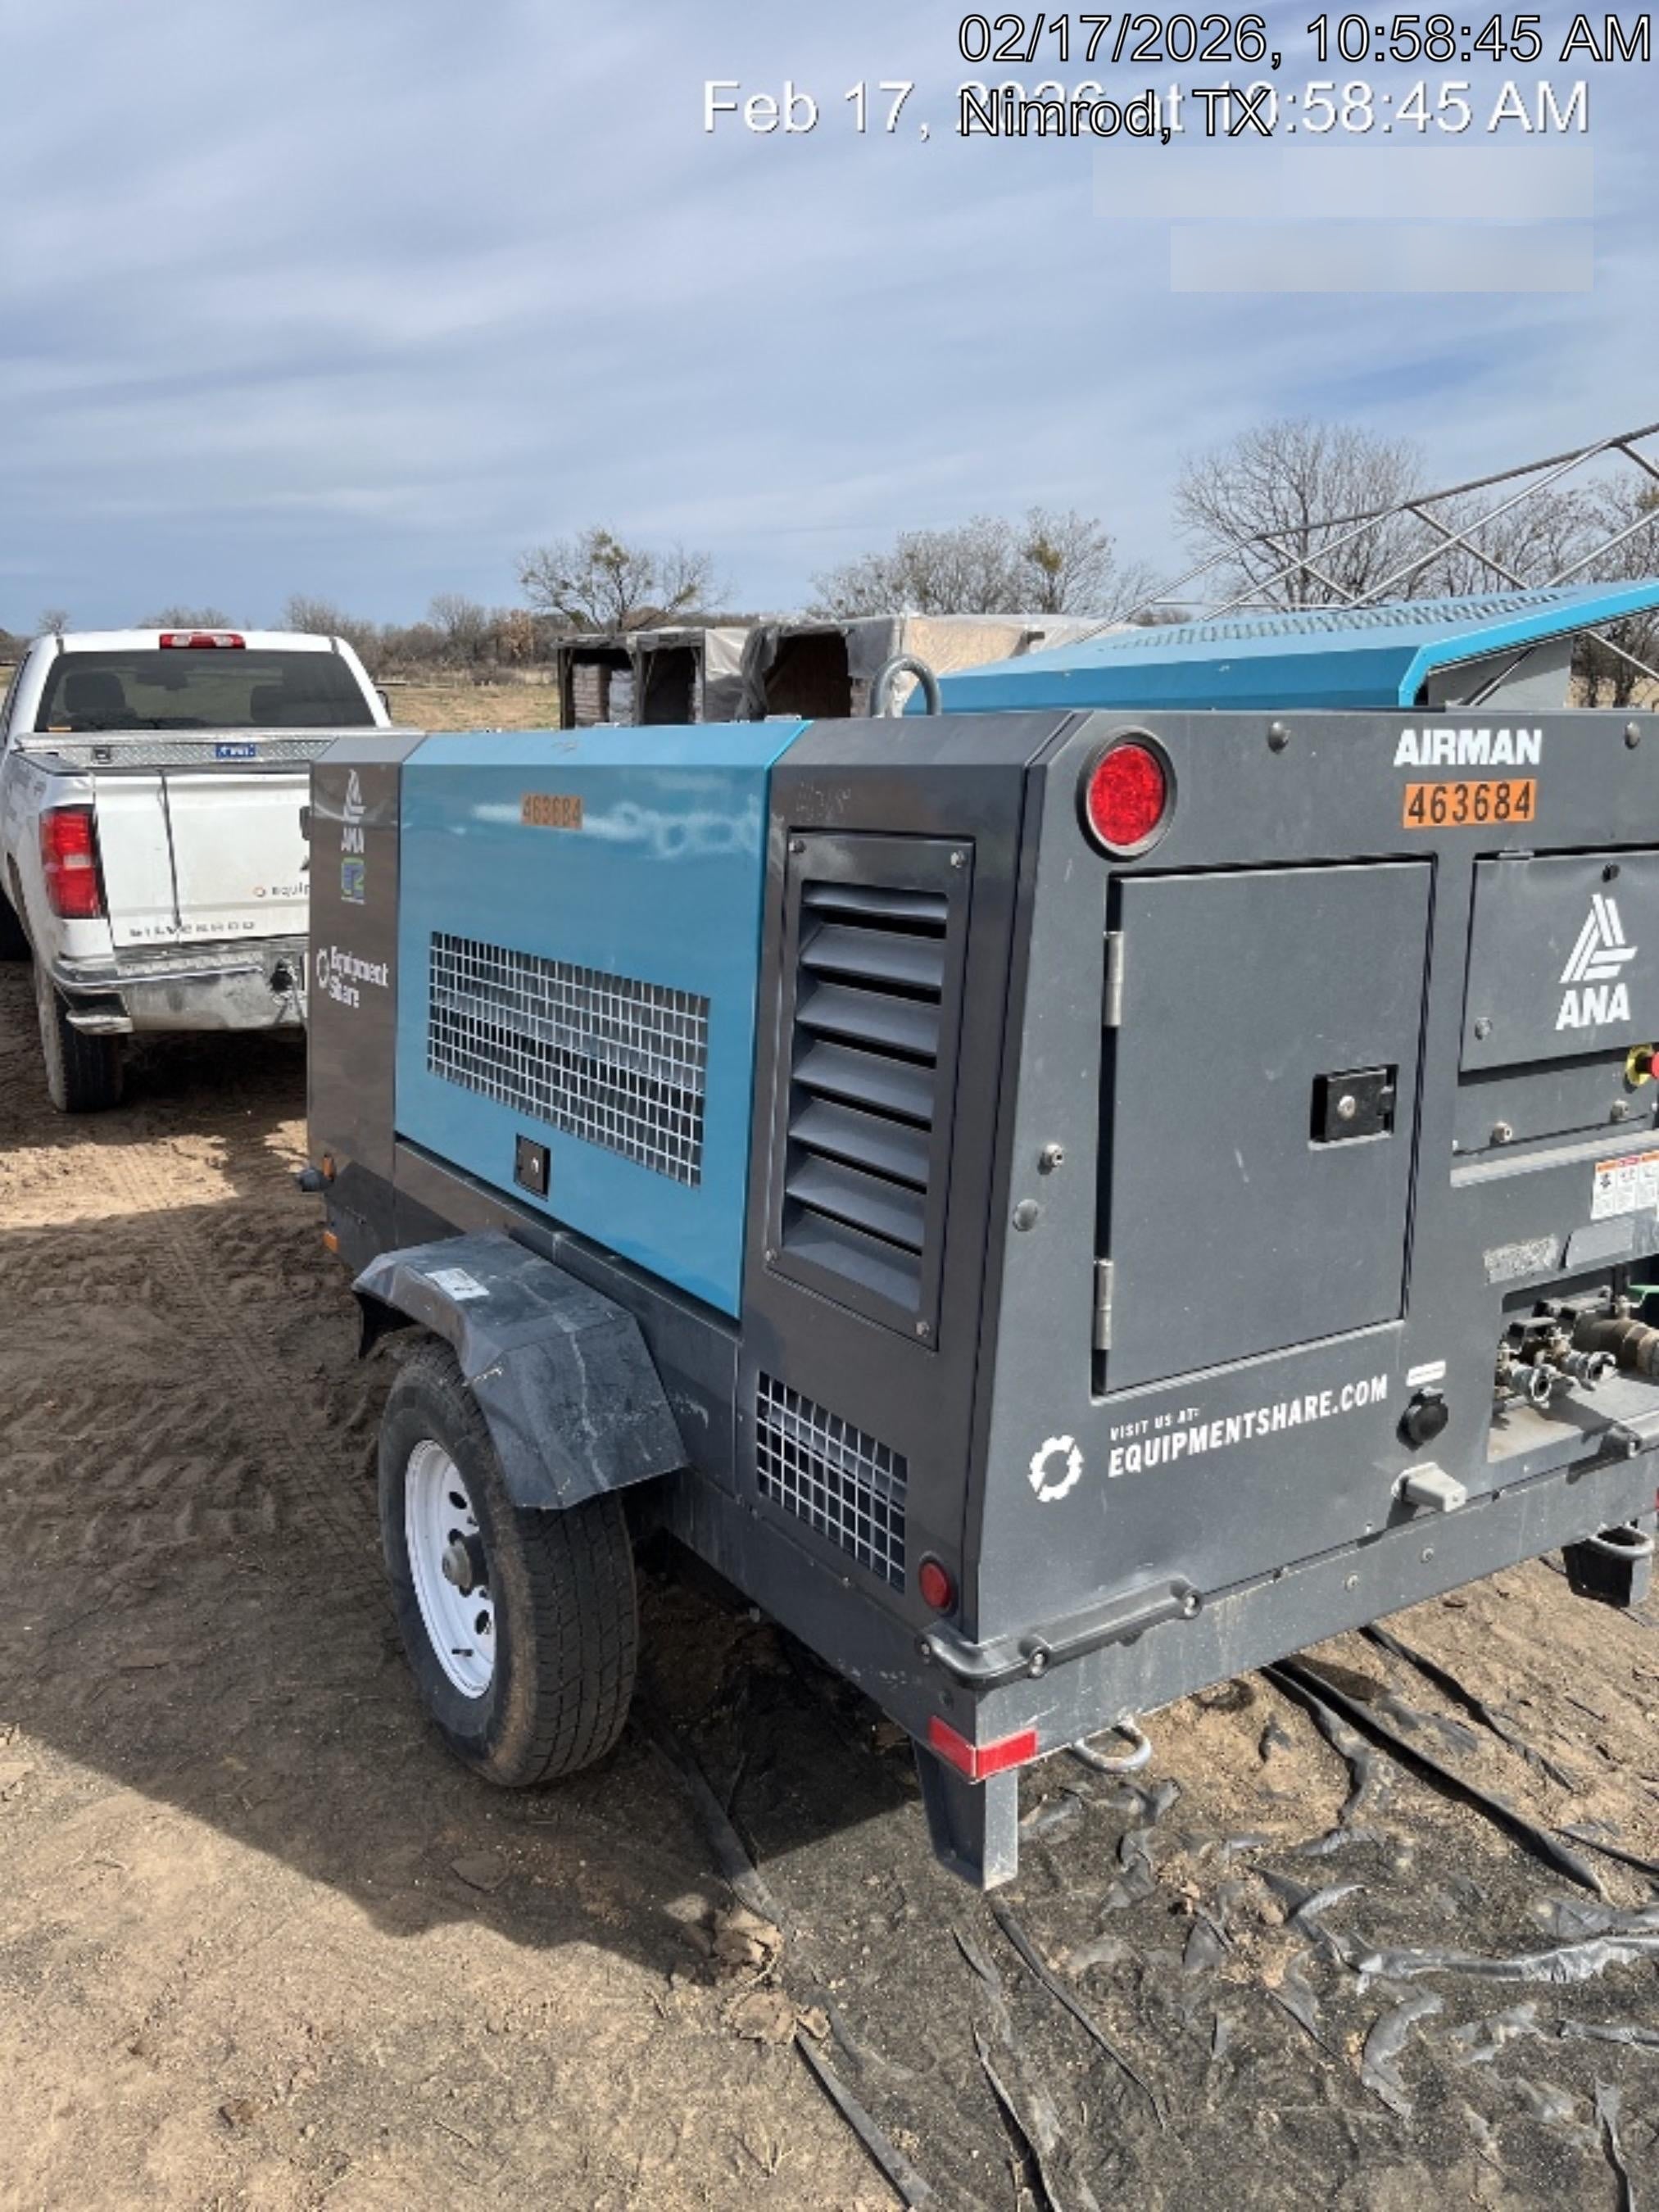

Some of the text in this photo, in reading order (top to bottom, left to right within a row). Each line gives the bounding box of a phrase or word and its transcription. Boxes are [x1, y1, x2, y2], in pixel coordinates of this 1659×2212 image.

[1393, 728, 1543, 767] AIRMAN
[1407, 782, 1532, 824] 463684
[330, 945, 389, 989] Equipment
[329, 975, 360, 1009] Share
[1555, 982, 1632, 1031] ANA
[1108, 1373, 1388, 1479] EQUIPMENTSHARE.COM
[1109, 1419, 1149, 1442] VISIT
[1154, 1412, 1173, 1430] US
